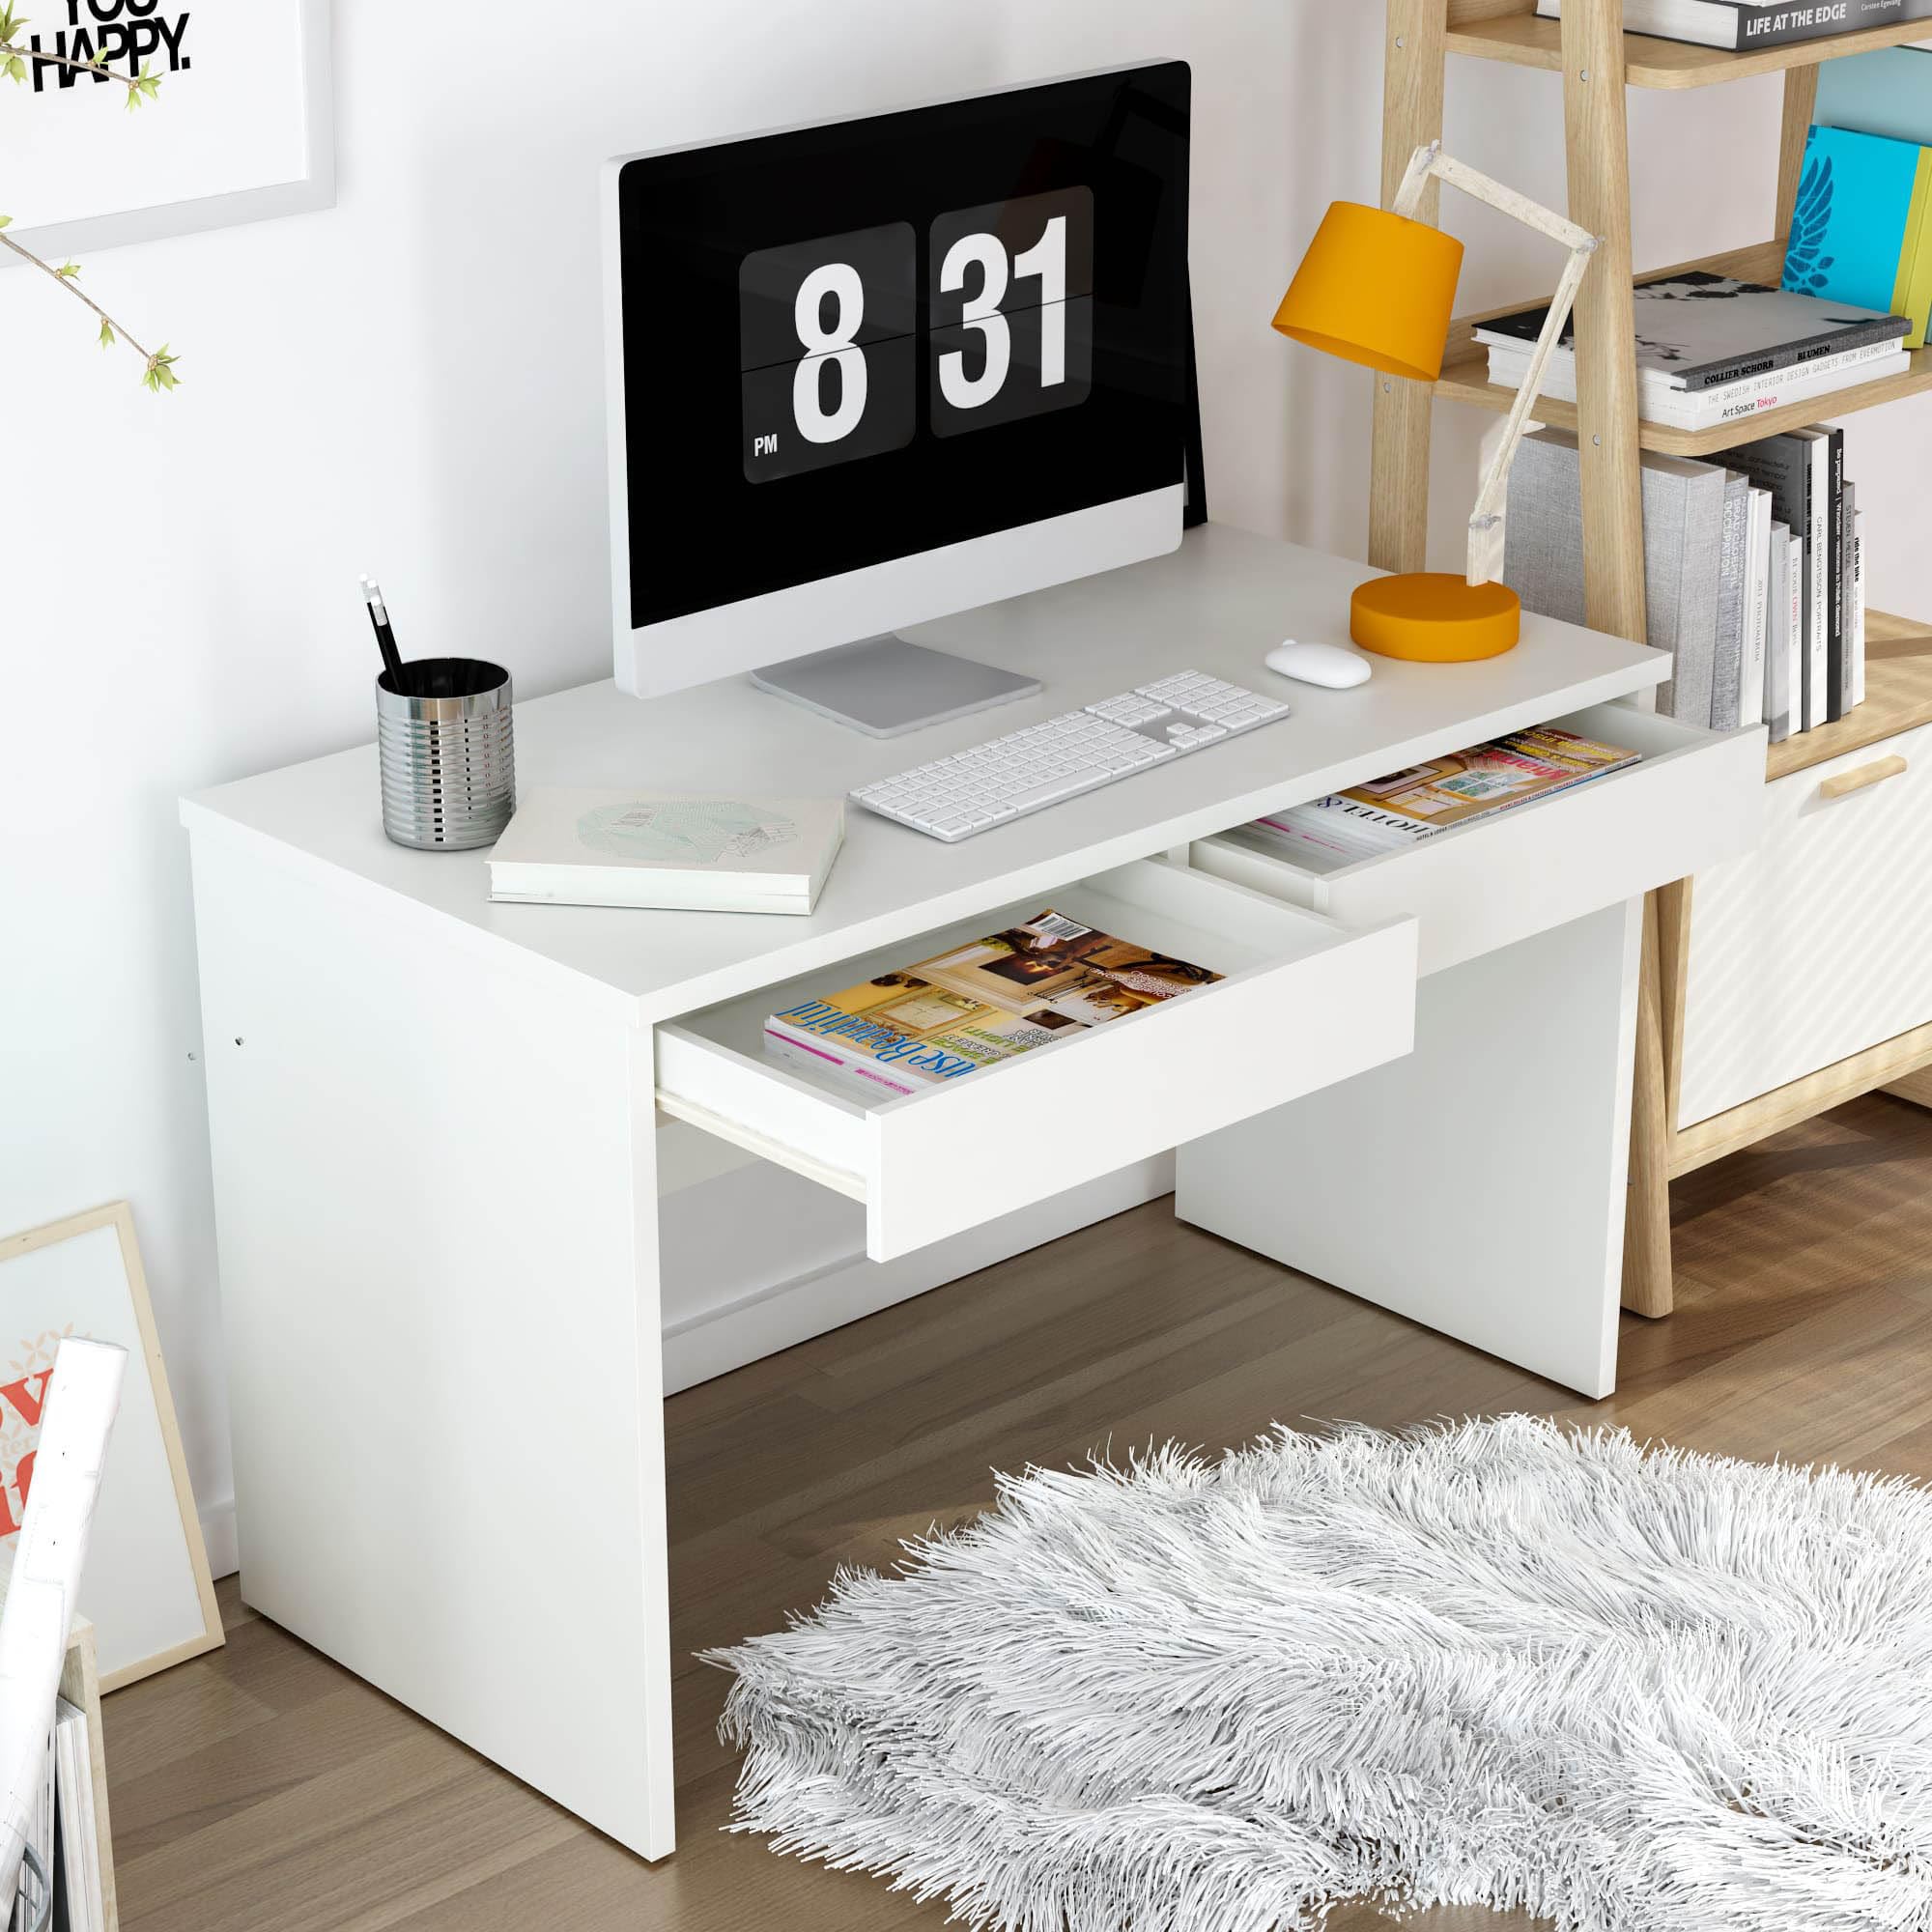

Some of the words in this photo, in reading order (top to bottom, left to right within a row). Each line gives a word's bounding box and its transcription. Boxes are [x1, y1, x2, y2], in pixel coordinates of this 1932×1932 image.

[1747, 15, 1772, 37] LIFE
[1773, 14, 1789, 32] AT
[1790, 9, 1813, 28] THE
[1816, 3, 1847, 24] EDGE
[31, 13, 190, 93] HAPPY.
[793, 262, 867, 444] 8
[938, 215, 1066, 410] 31
[1704, 369, 1740, 385] COLLIER
[1741, 359, 1774, 376] SCHORR
[1708, 392, 1719, 404] THE
[1723, 384, 1750, 401] SWEDISH
[1754, 374, 1784, 391] INTERIOR
[1787, 367, 1809, 383] DESIGN
[1812, 357, 1838, 374] GADGETS
[1841, 354, 1857, 367] FROM
[1860, 340, 1895, 360] EVERMOTION
[1721, 403, 1734, 418] Art
[1735, 400, 1755, 416] Space
[1756, 395, 1777, 409] Tokyo
[753, 434, 778, 457] PM
[1721, 500, 1733, 577] OCCUPATION
[1317, 797, 1343, 809] &
[1342, 803, 1430, 834] HOTEL
[775, 1001, 928, 1064] Beautiful
[908, 1049, 976, 1079] use
